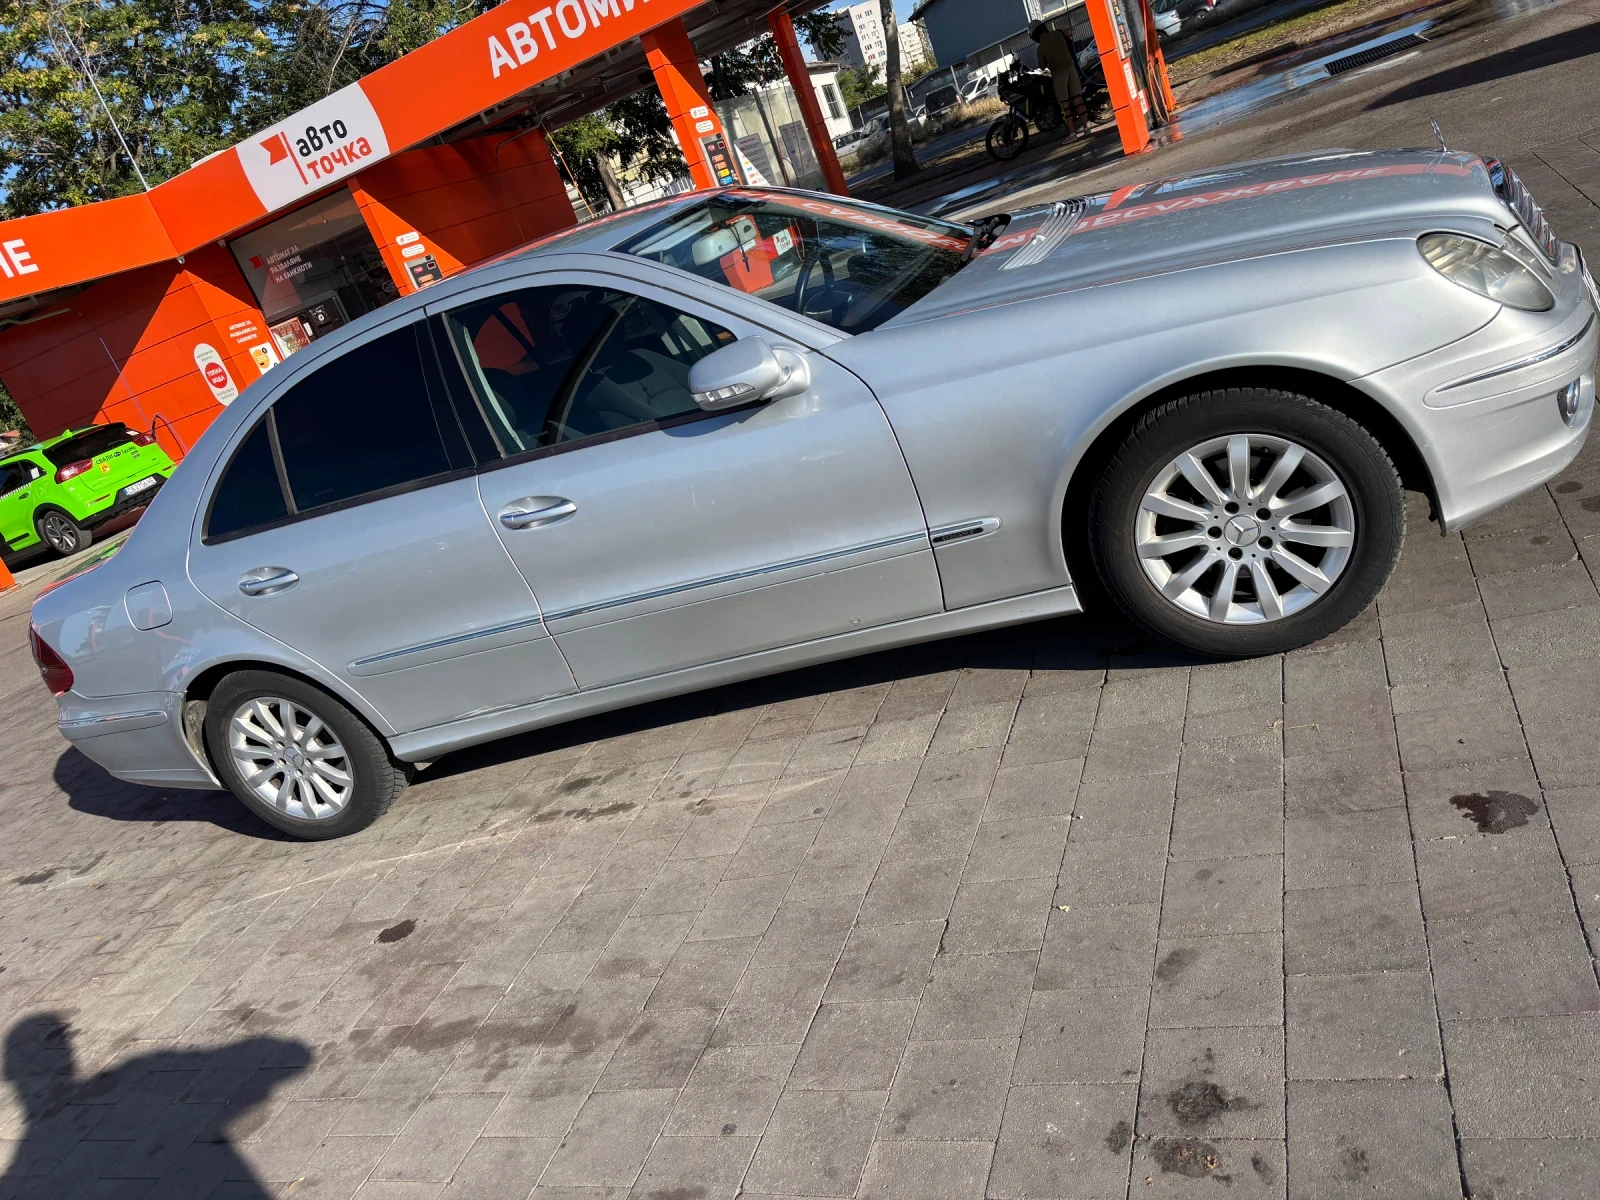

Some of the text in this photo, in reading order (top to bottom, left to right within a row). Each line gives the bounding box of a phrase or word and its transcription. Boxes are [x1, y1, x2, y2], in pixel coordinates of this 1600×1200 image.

[487, 0, 648, 79] АВТОМ
[296, 120, 348, 158] авто
[306, 136, 373, 180] точка
[266, 244, 300, 265] АВТОМАТ ЗА
[270, 254, 302, 275] РАЗВАЛЯНЕ
[274, 273, 285, 284] НА
